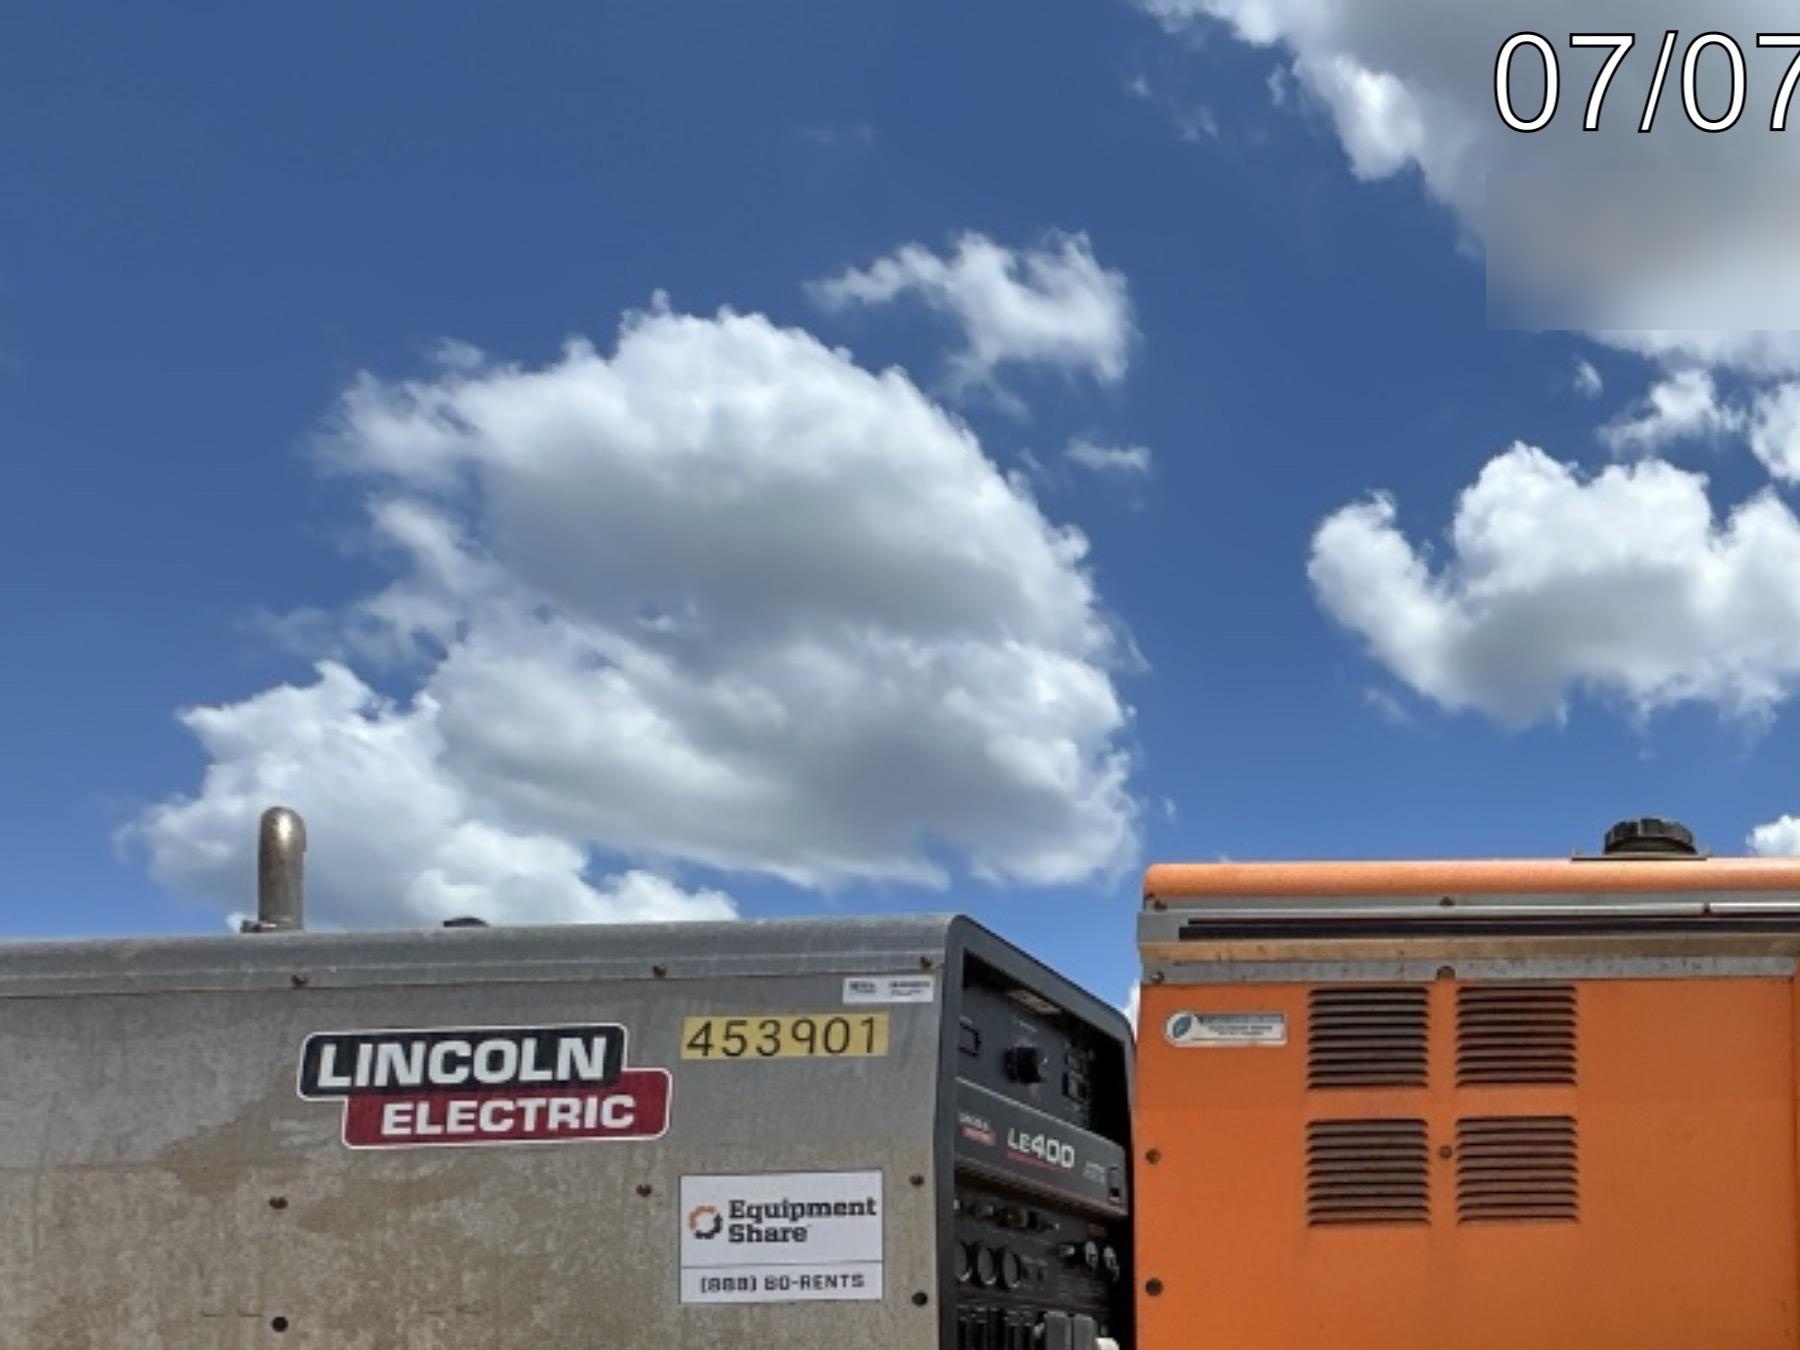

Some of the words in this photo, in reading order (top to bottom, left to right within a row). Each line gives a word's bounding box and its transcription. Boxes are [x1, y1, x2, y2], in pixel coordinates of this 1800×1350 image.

[686, 1015, 876, 1057] 453901
[316, 1036, 608, 1088] LINCOLN
[380, 1094, 637, 1136] ELECTRIC
[1006, 1127, 1076, 1169] LE400
[728, 1197, 877, 1224] Equipment
[728, 1224, 808, 1244] Share
